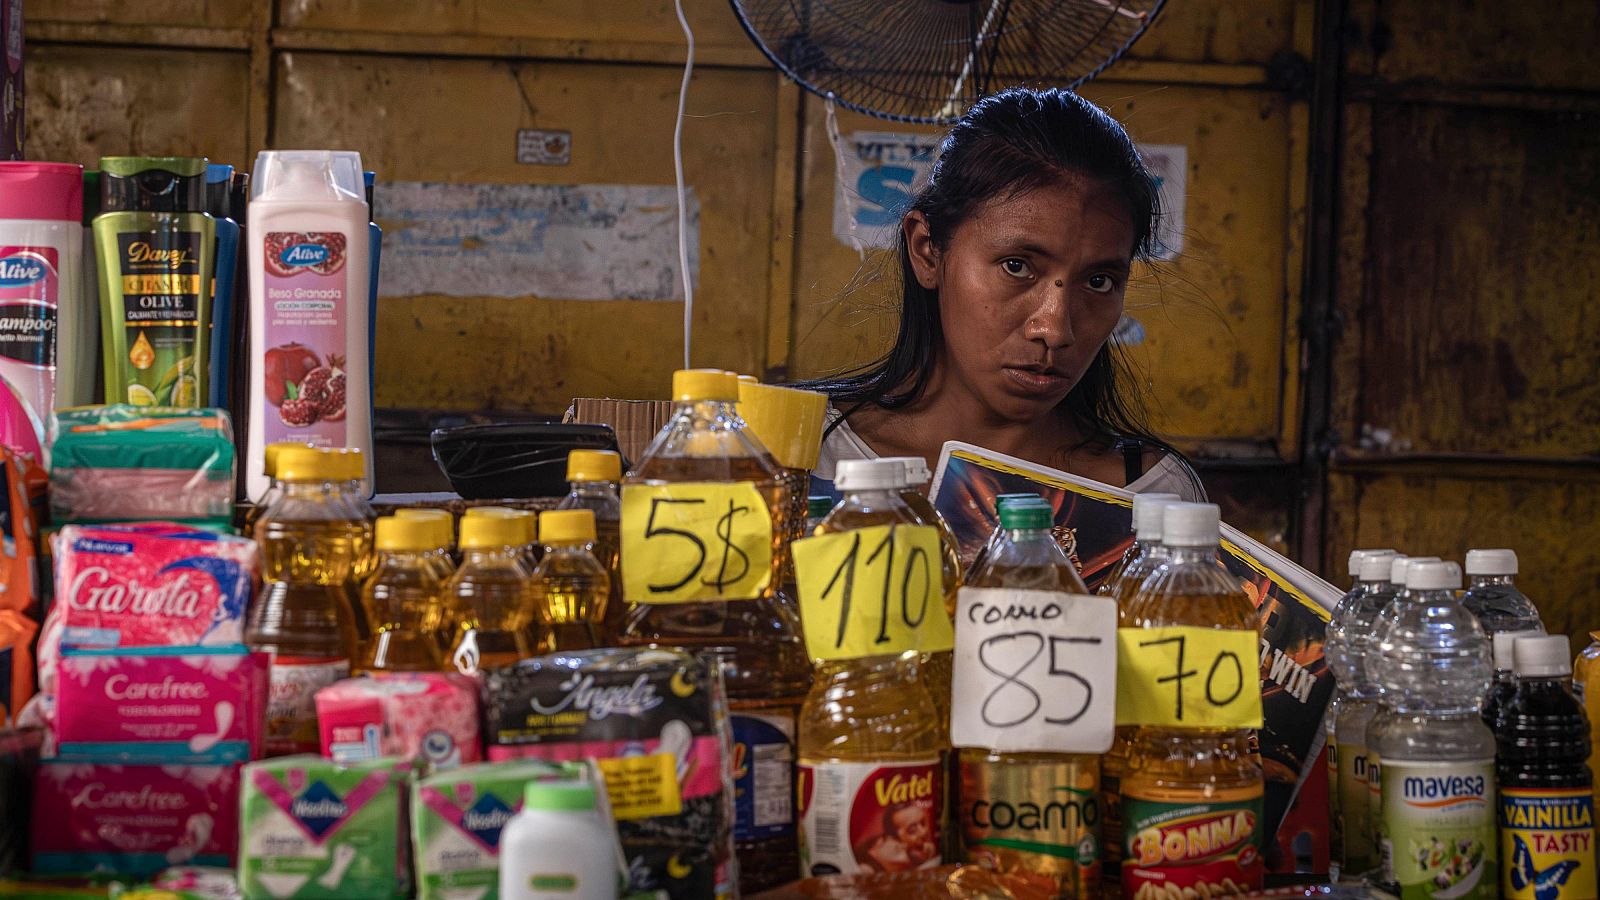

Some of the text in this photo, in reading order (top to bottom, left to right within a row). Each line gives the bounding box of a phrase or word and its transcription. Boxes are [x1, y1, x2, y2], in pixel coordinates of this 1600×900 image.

[287, 246, 324, 262] Alive
[139, 296, 184, 308] OLIVE
[268, 288, 341, 299] Beso Granada
[645, 498, 750, 593] 5$
[821, 524, 930, 648] 110
[104, 674, 207, 700] Carefree
[978, 631, 1102, 728] 85
[1139, 636, 1244, 720] 70
[1269, 648, 1317, 704] WIN
[875, 770, 933, 806] Vatel
[1403, 775, 1485, 799] mavesa
[971, 799, 1098, 830] coamo
[1504, 804, 1591, 828] VAINILLA
[1138, 810, 1252, 866] BONNA
[1531, 832, 1591, 853] TASTY
